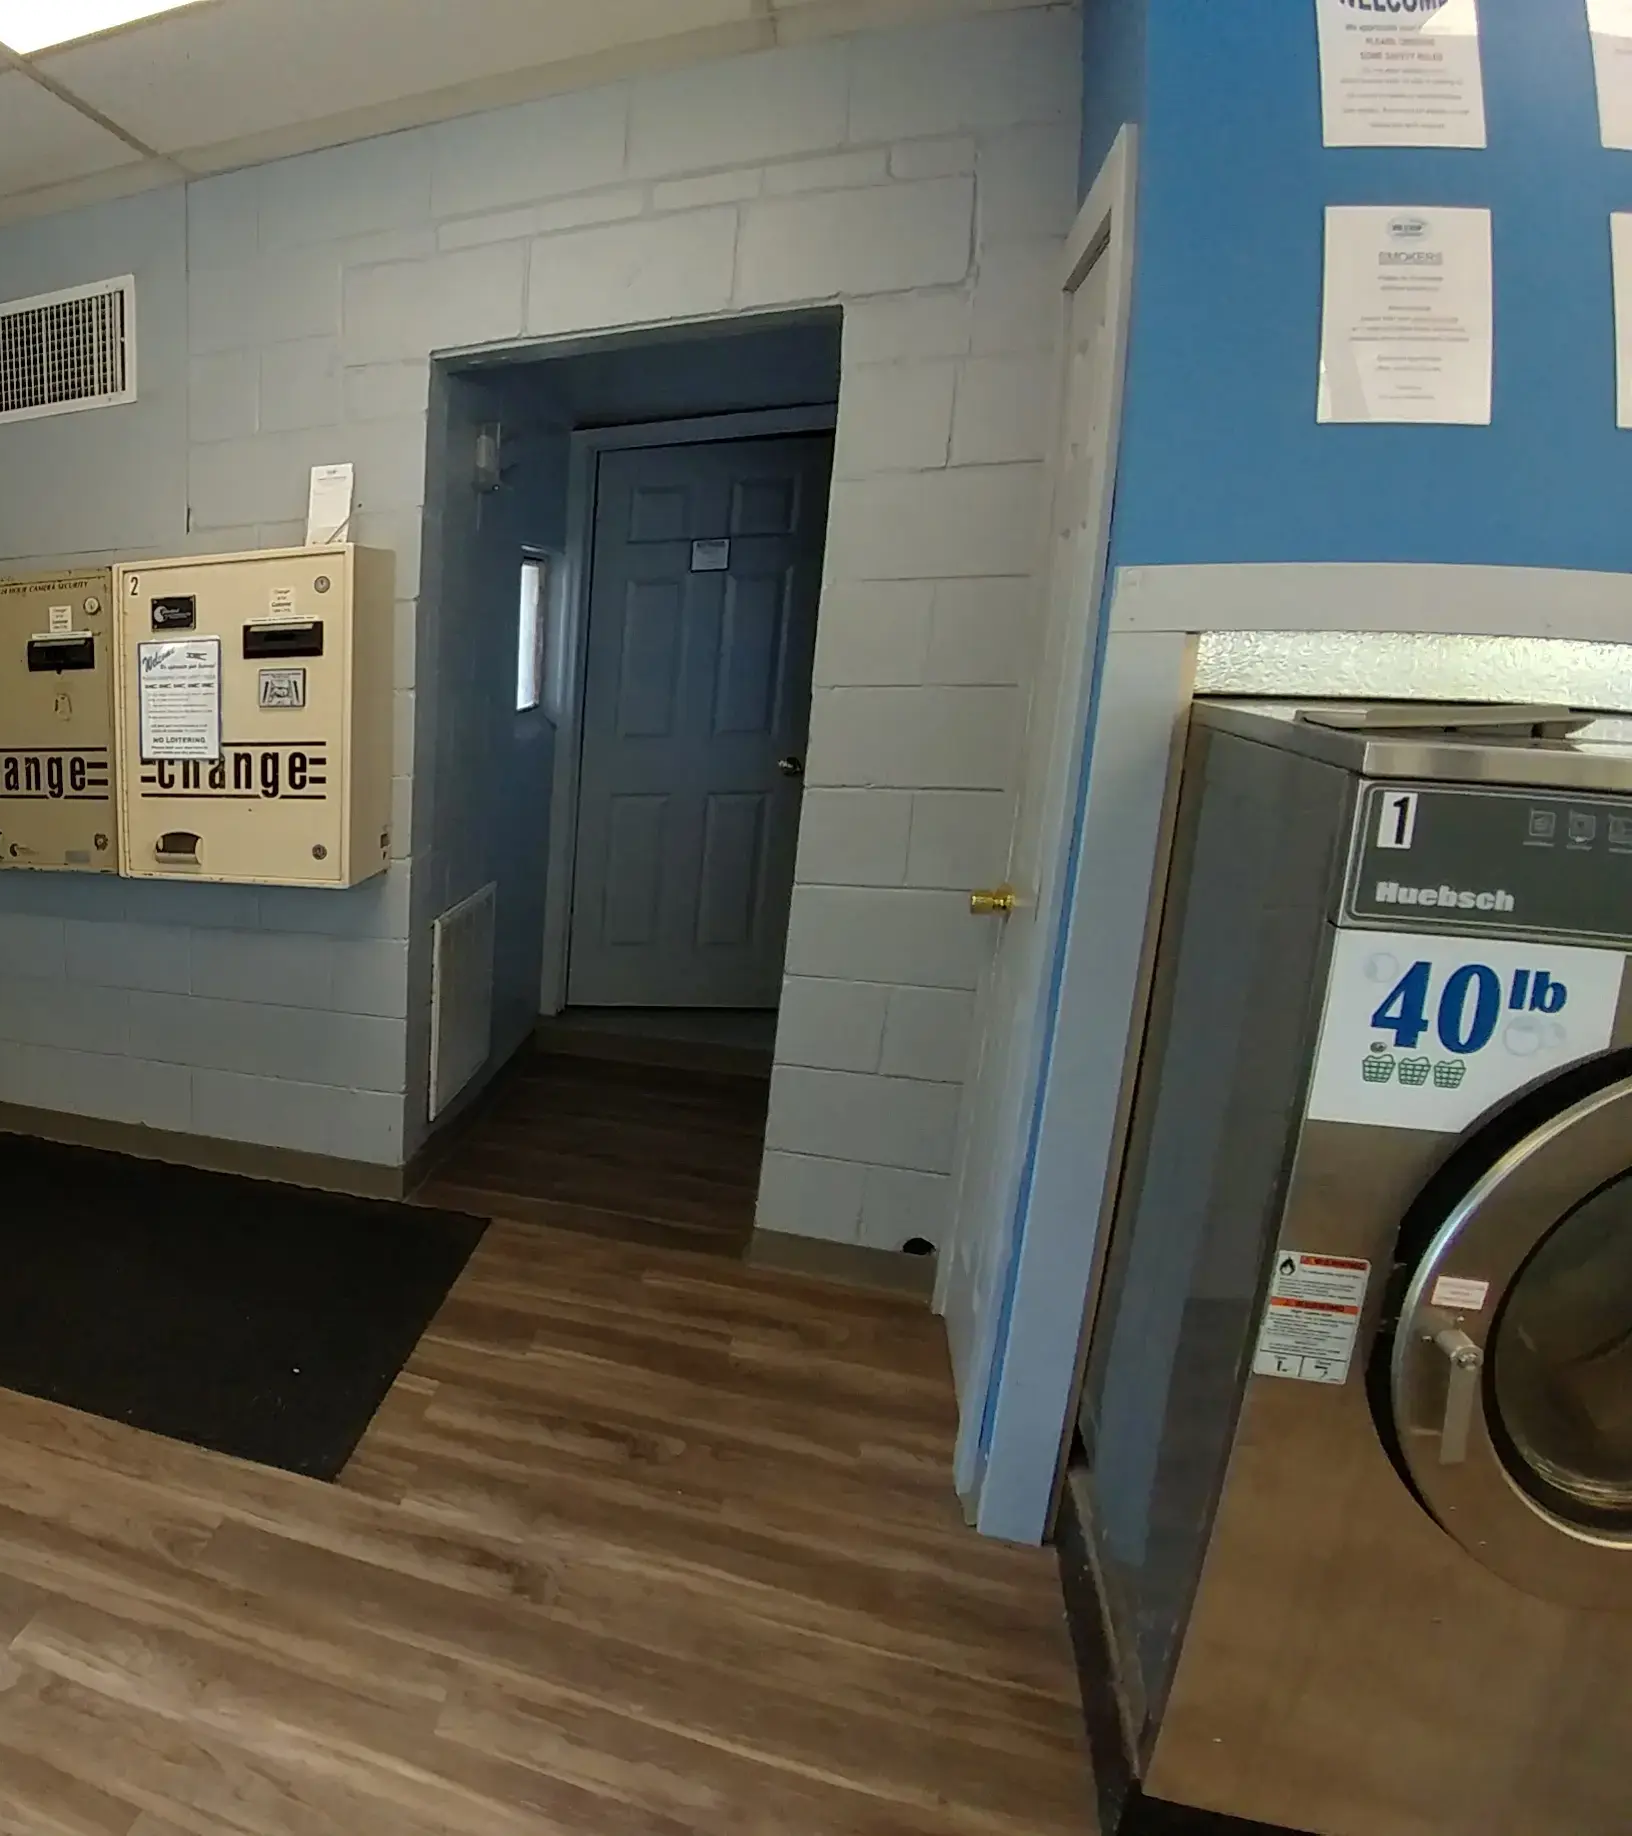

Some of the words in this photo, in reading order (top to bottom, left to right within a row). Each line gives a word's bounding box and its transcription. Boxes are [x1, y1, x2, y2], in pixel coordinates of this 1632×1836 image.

[130, 576, 139, 596] 2
[152, 736, 164, 744] NO
[165, 736, 206, 744] LOITERING
[1392, 796, 1411, 846] 1
[1375, 881, 1515, 912] Huebsch
